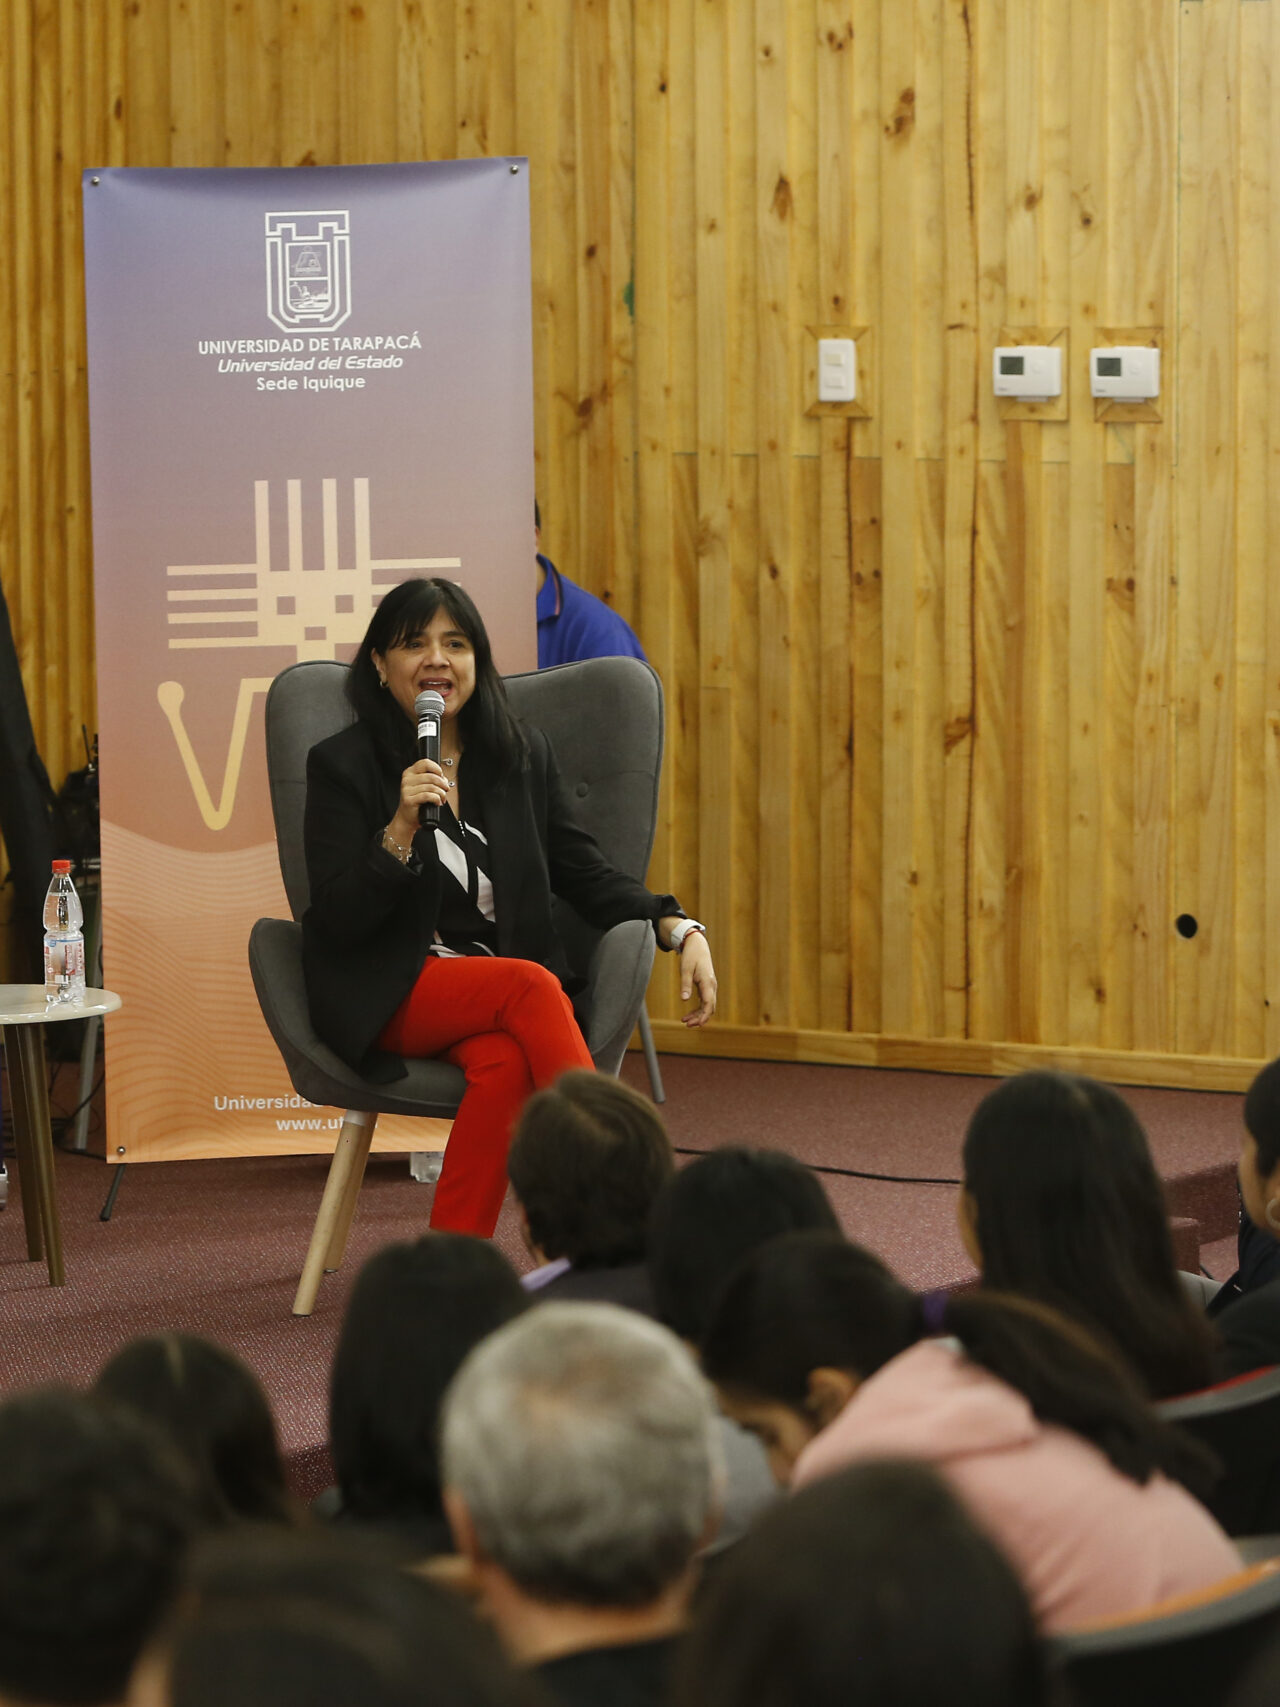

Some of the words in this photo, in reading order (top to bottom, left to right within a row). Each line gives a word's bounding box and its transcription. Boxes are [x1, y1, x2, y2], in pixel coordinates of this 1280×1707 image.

[198, 339, 304, 354] UNIVERSIDAD
[309, 338, 329, 351] DE
[332, 331, 422, 350] TARAPACÁ
[217, 357, 315, 373] Universidad
[318, 356, 342, 370] del
[345, 355, 404, 369] Estado
[256, 376, 299, 391] Sede
[303, 375, 366, 393] Iquique
[213, 1092, 324, 1111] Universida
